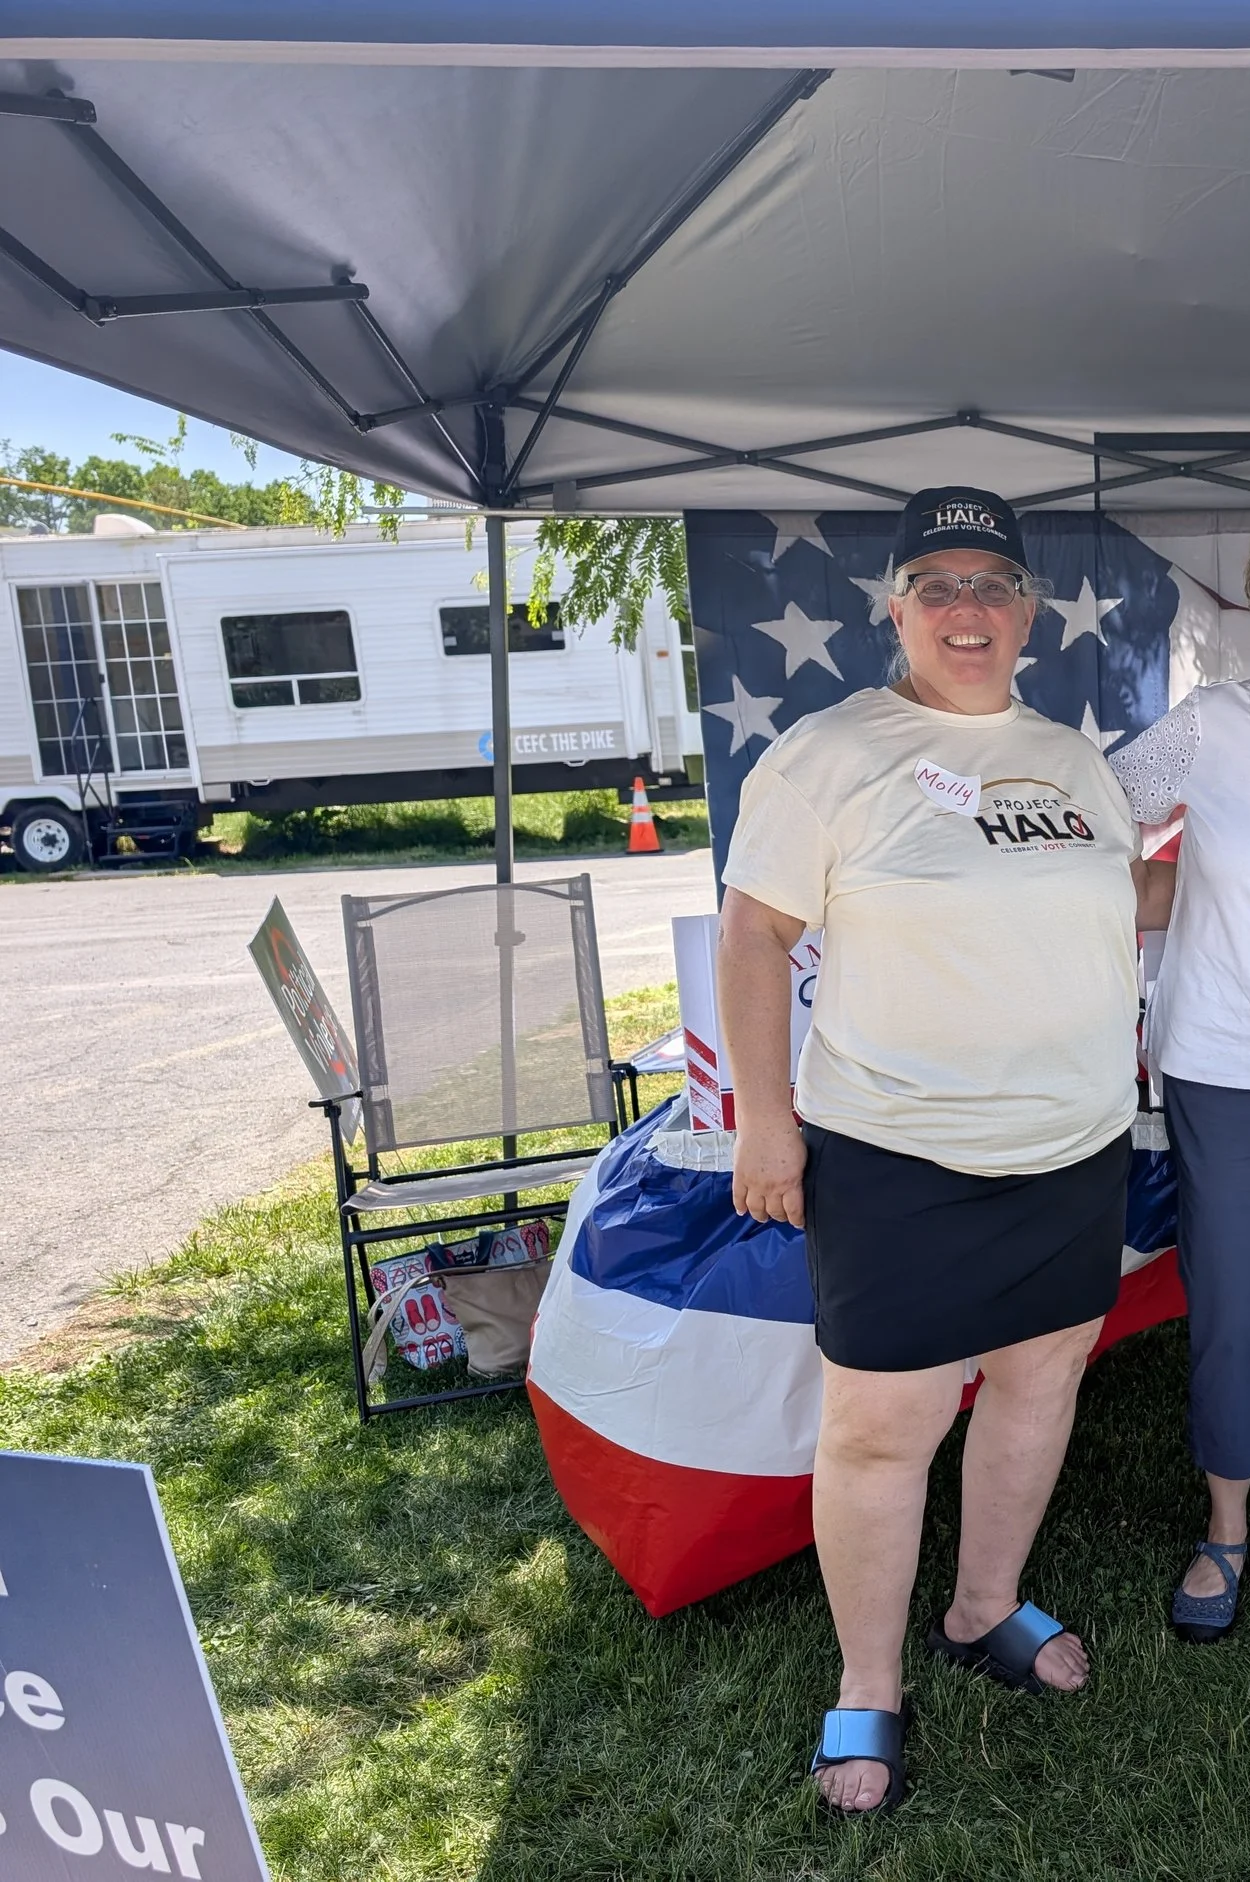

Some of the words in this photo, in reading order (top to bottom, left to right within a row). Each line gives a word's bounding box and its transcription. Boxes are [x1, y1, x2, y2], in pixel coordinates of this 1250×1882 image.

[946, 503, 983, 511] PROJECT
[936, 509, 995, 528] HALO
[923, 524, 959, 537] CELEBRATE
[960, 524, 981, 532] VOTE
[515, 733, 549, 753] CEFC
[550, 731, 579, 752] THE
[580, 729, 616, 749] PIKE
[917, 768, 973, 806] Molly
[993, 799, 1061, 811] PROJECT
[973, 810, 1095, 845] HALO
[1000, 845, 1040, 854] CELEBRATE
[1041, 843, 1066, 851] VOTE
[30, 1778, 205, 1881] Our
